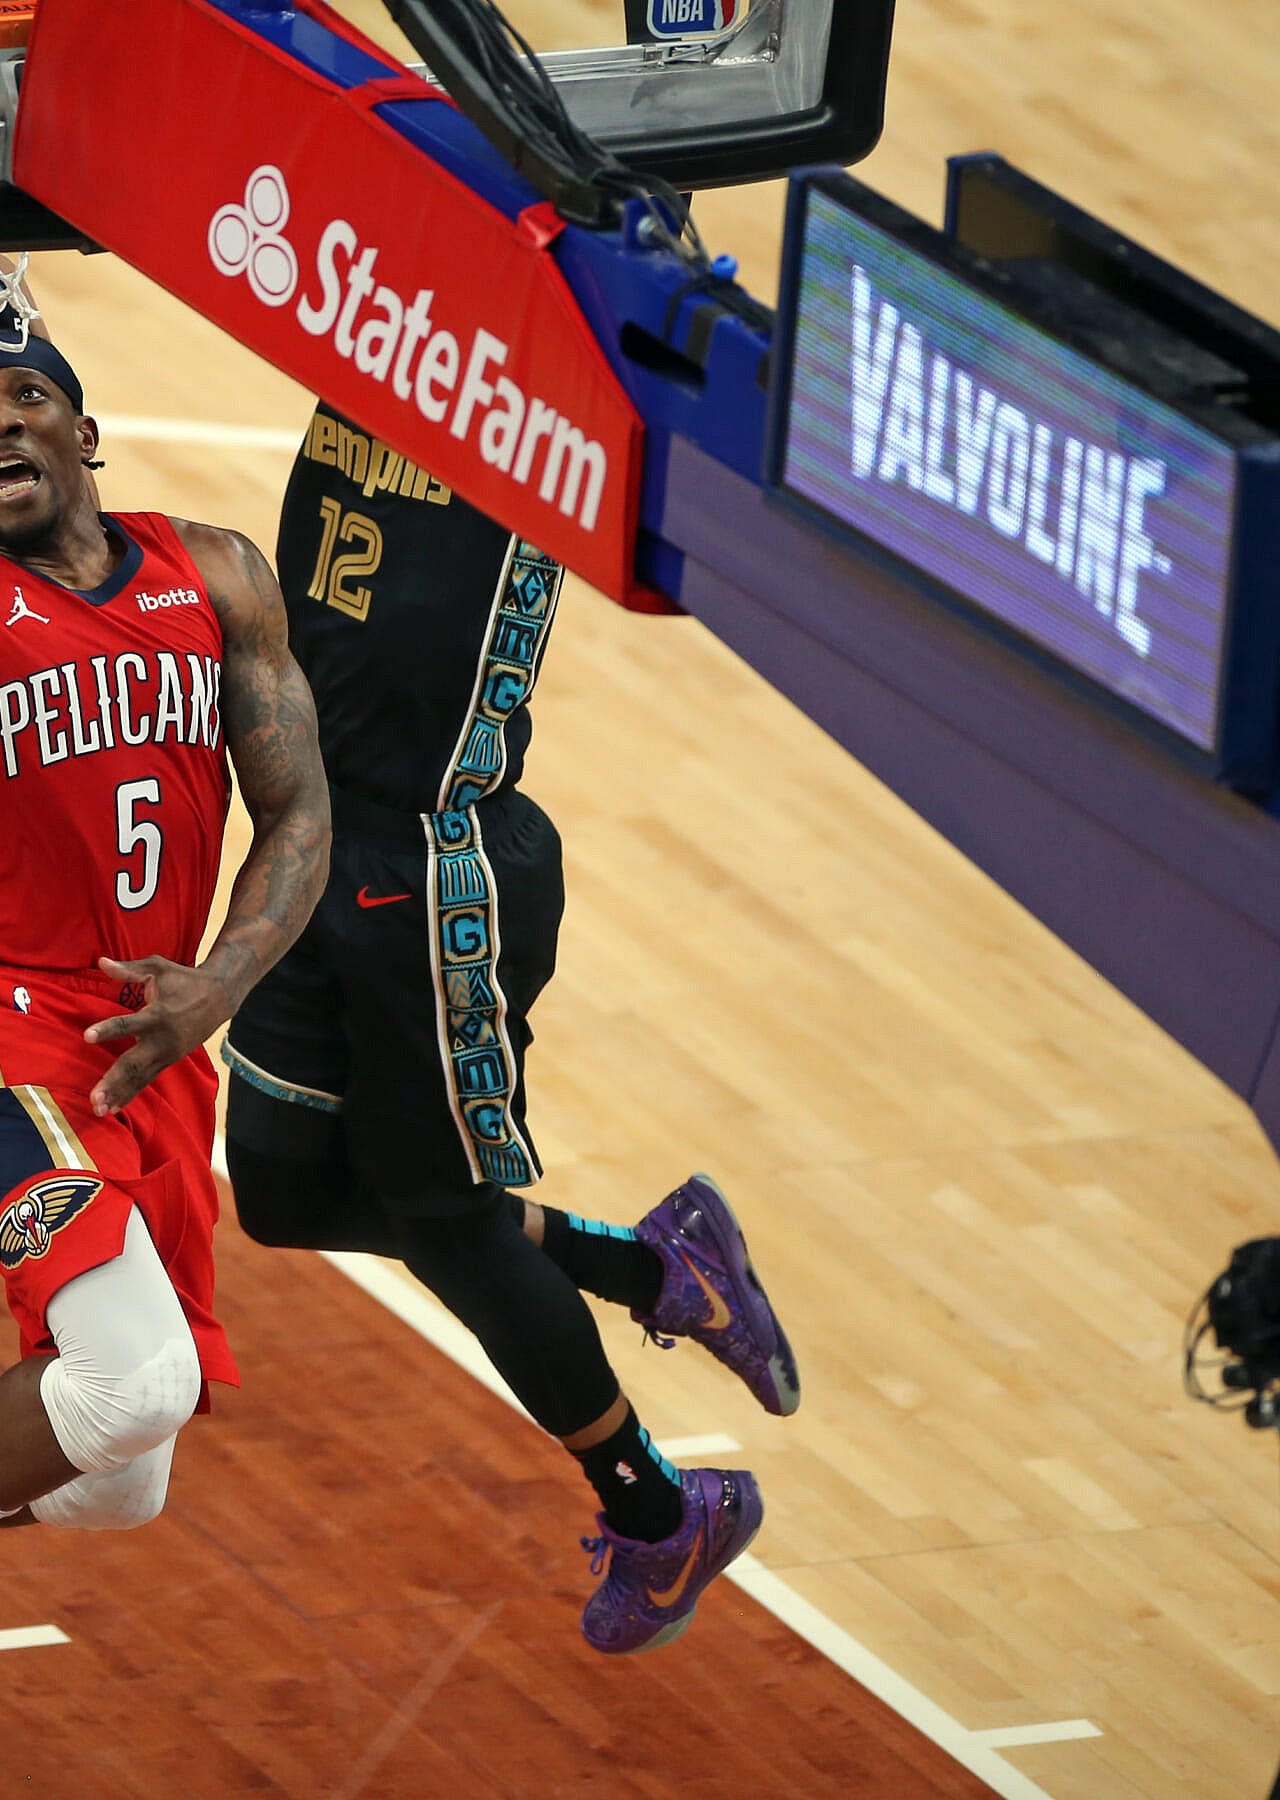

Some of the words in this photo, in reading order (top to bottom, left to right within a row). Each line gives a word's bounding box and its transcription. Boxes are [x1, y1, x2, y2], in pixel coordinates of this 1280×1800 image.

[661, 0, 704, 24] NBA
[851, 264, 1167, 660] VALVOLINE
[135, 587, 200, 613] ibotta
[307, 495, 383, 623] 12
[115, 776, 164, 911] 5
